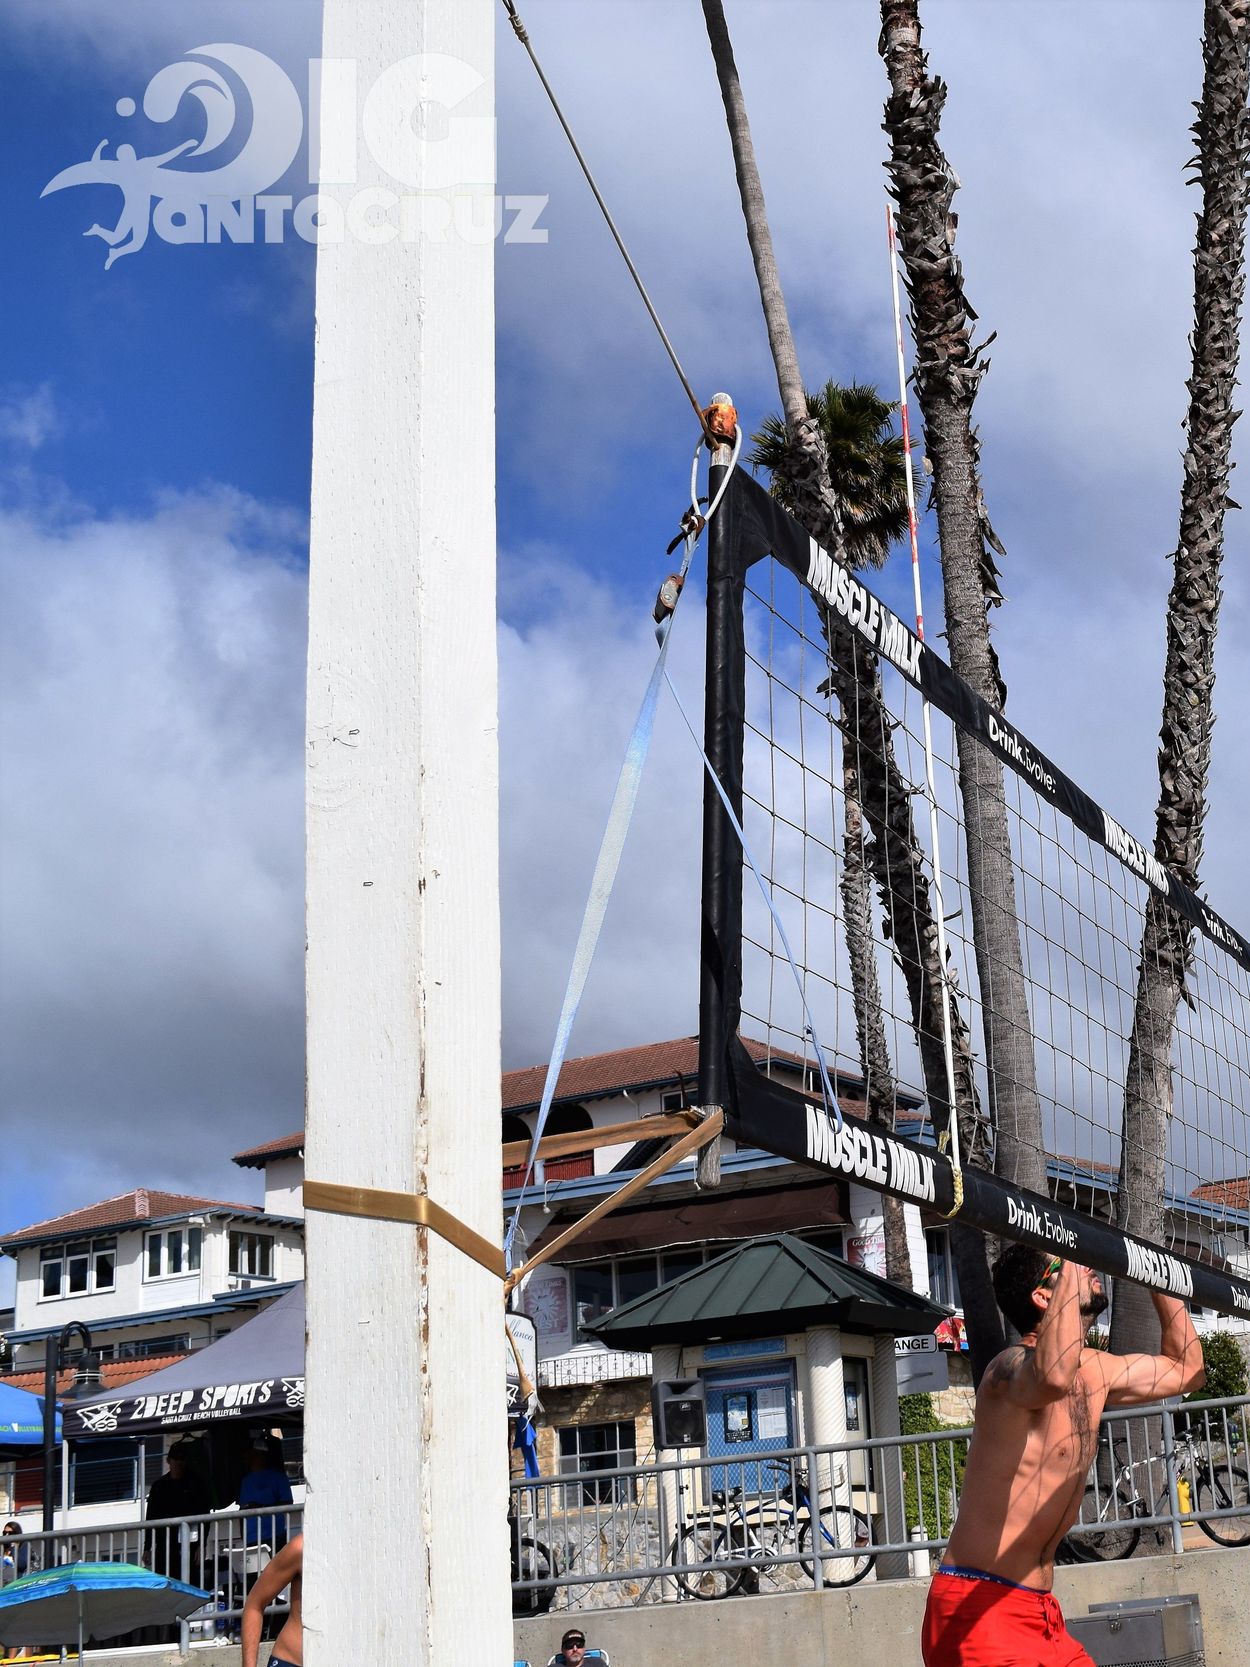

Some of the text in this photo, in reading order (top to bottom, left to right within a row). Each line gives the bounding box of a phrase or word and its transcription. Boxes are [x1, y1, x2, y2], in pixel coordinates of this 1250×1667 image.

[806, 536, 925, 685] MUSCLE MILK
[804, 1103, 937, 1203] MUSCLE MILK
[1123, 1236, 1169, 1289] MUSCLE
[894, 1338, 929, 1350] ANGE
[129, 1380, 275, 1419] 2DEEP SPORTS
[211, 1407, 242, 1418] VOLLEYBALL
